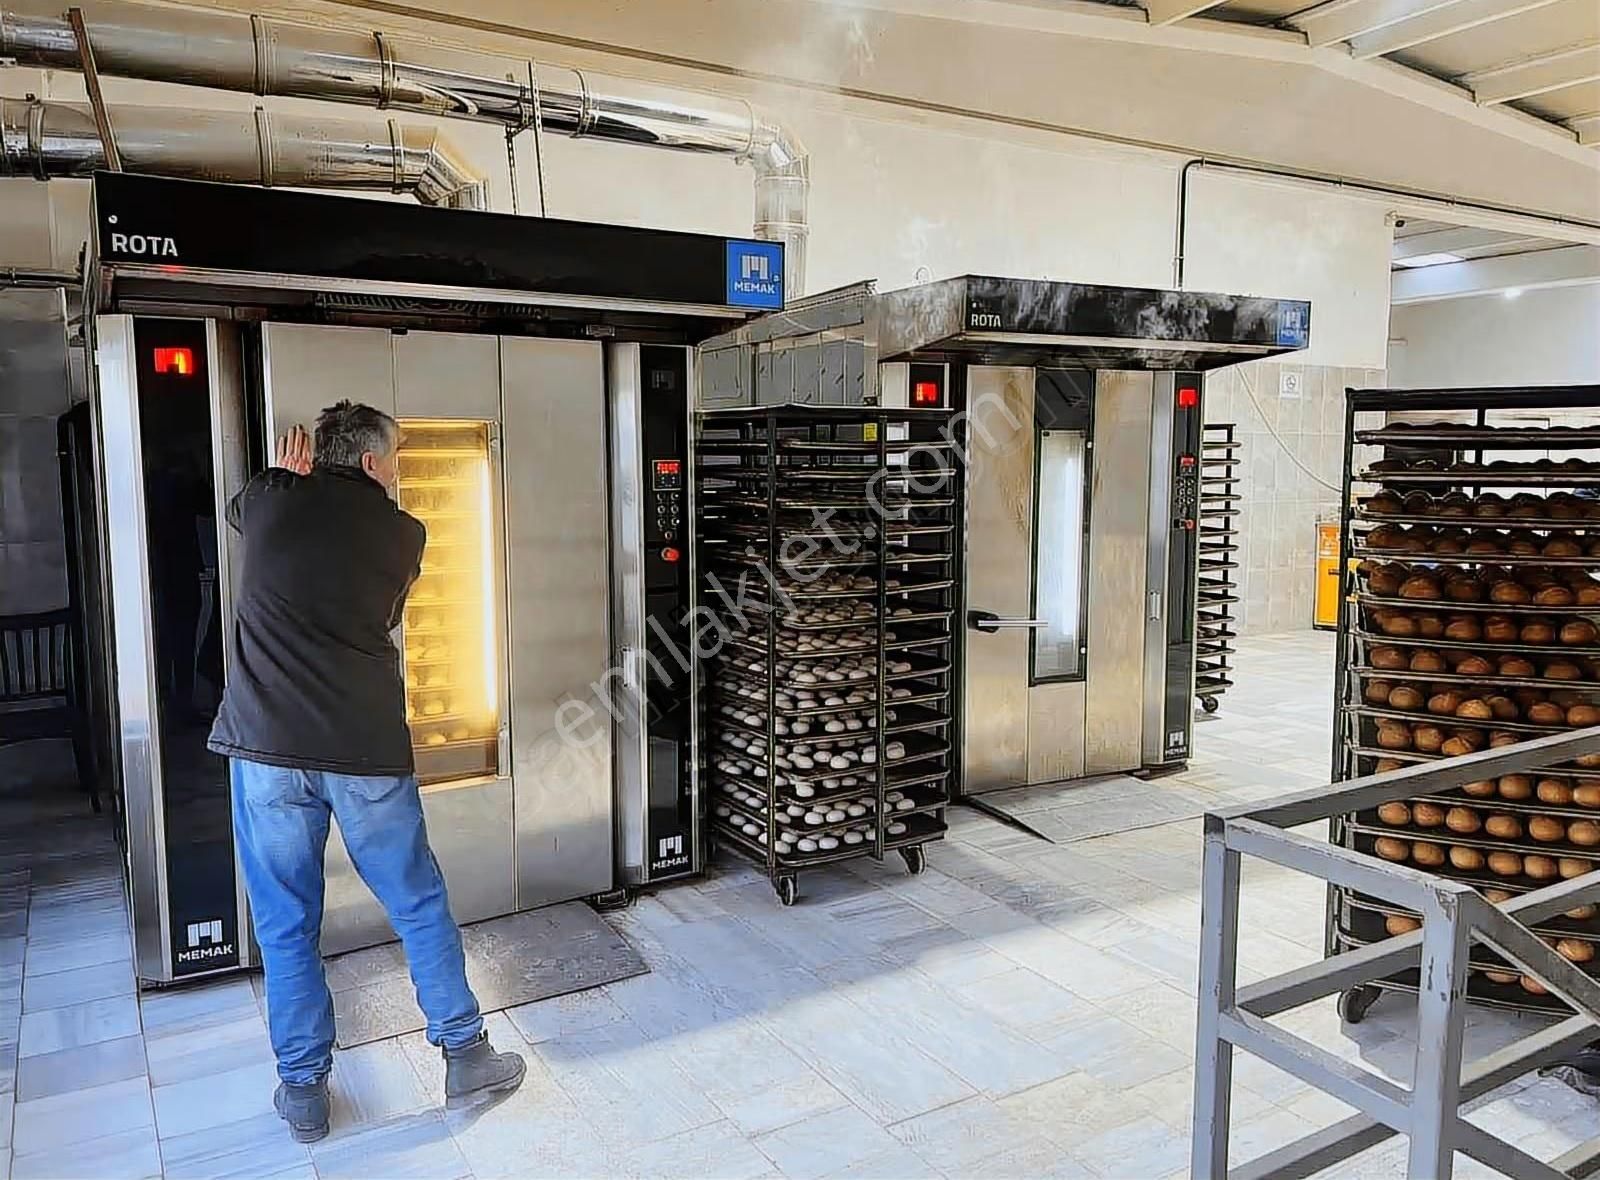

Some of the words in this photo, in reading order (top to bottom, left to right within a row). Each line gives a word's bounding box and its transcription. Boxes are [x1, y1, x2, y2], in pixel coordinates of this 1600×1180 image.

[111, 232, 179, 257] ROTA
[734, 281, 776, 294] MEMAK
[971, 313, 1001, 328] ROTA
[652, 855, 688, 870] MEMAK
[178, 944, 233, 962] MEMAK
